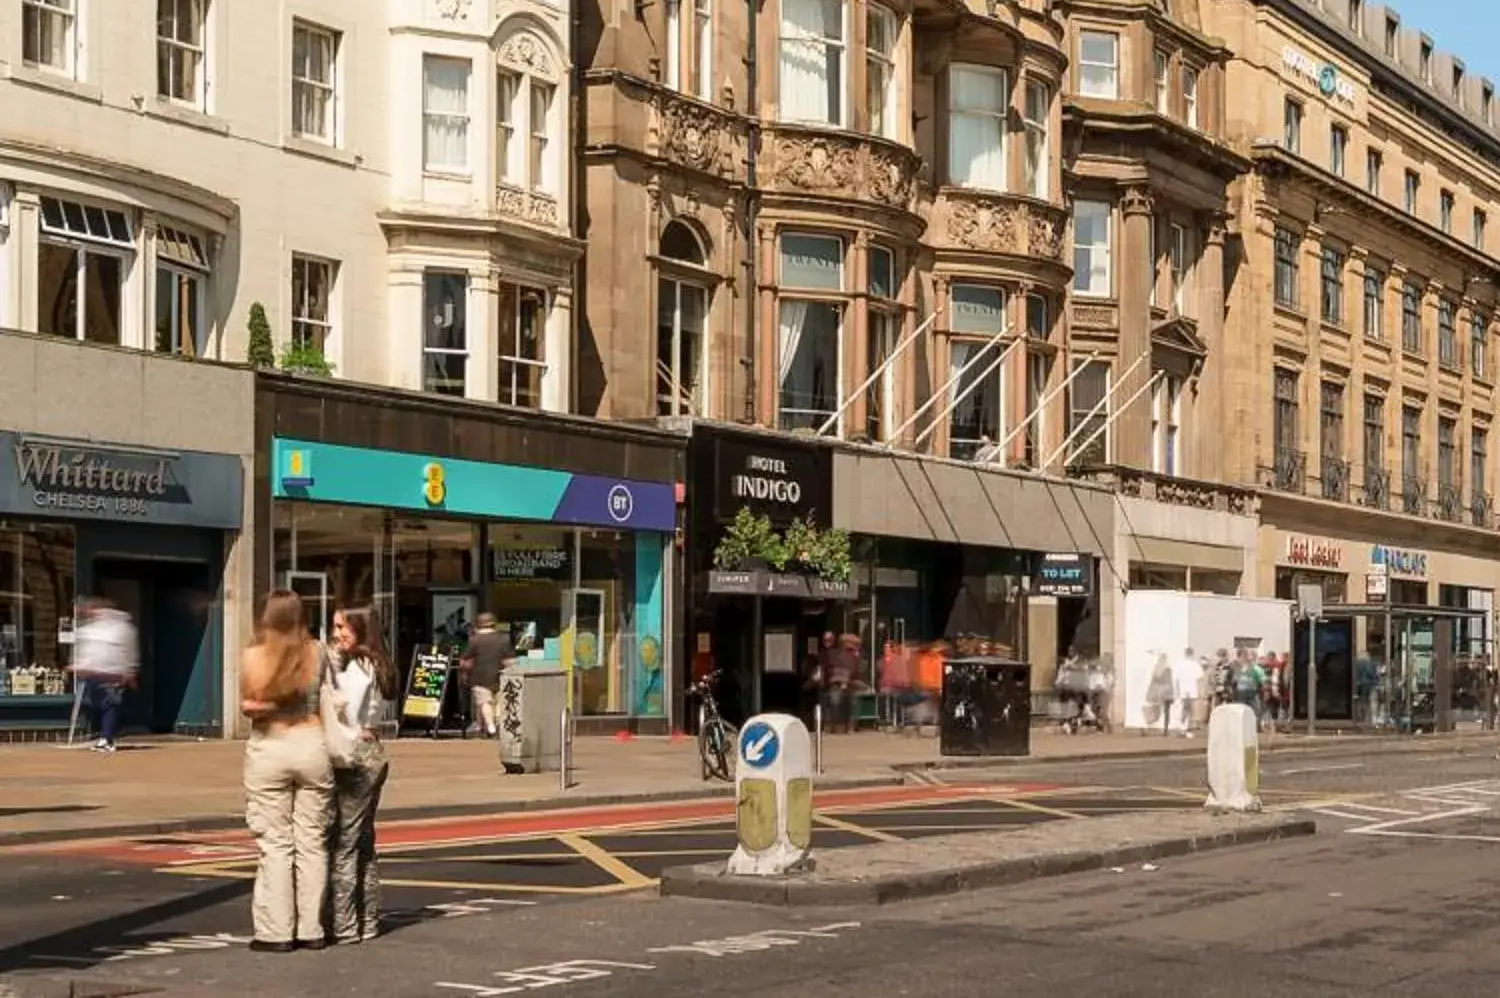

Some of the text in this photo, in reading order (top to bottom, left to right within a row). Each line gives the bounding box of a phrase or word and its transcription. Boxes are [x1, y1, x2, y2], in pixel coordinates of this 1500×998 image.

[14, 443, 167, 495] Whittard
[748, 456, 787, 474] HOTEL
[735, 475, 800, 503] INDIGO
[32, 490, 106, 511] CHELSEA
[613, 495, 627, 510] BT
[1042, 568, 1081, 579] TO LET
[433, 959, 657, 996] LEFT
